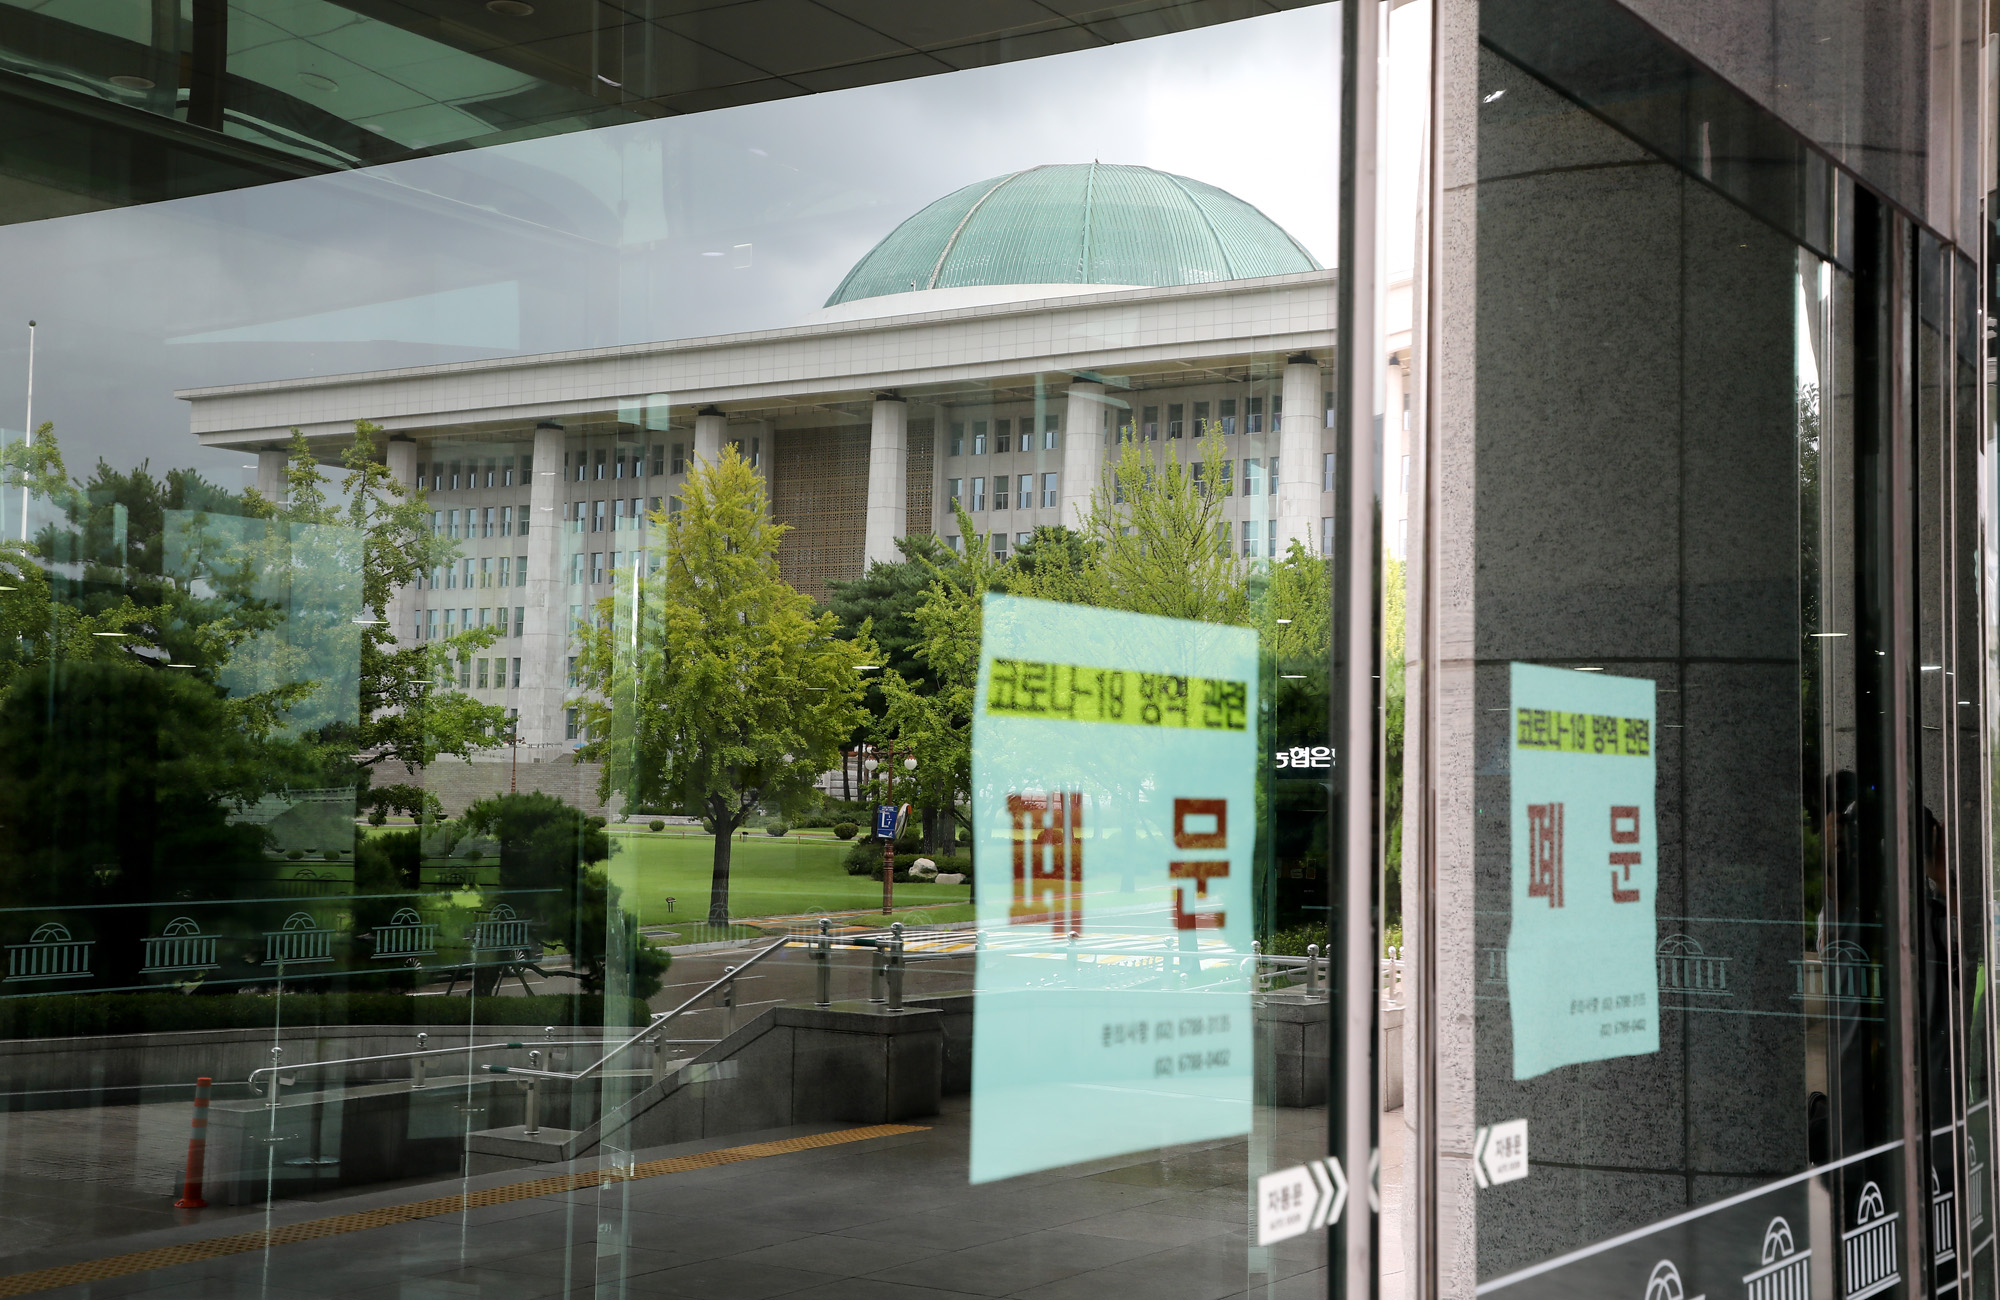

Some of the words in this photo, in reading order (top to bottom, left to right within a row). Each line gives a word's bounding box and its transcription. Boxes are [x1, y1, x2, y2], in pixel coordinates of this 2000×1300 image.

[990, 659, 1123, 719] 코로나-19
[1140, 671, 1188, 727] 방역
[1203, 680, 1246, 729] 관련
[1518, 708, 1585, 750] 코로나-19
[1592, 714, 1618, 753] 방역
[1625, 718, 1649, 756] 관련
[1169, 798, 1230, 931] 문
[1527, 802, 1563, 908] 폐
[1609, 806, 1641, 904] 문
[1102, 1020, 1148, 1047] 문의사항
[1495, 1134, 1521, 1158] 자동문
[1268, 1183, 1303, 1213] 자동문
